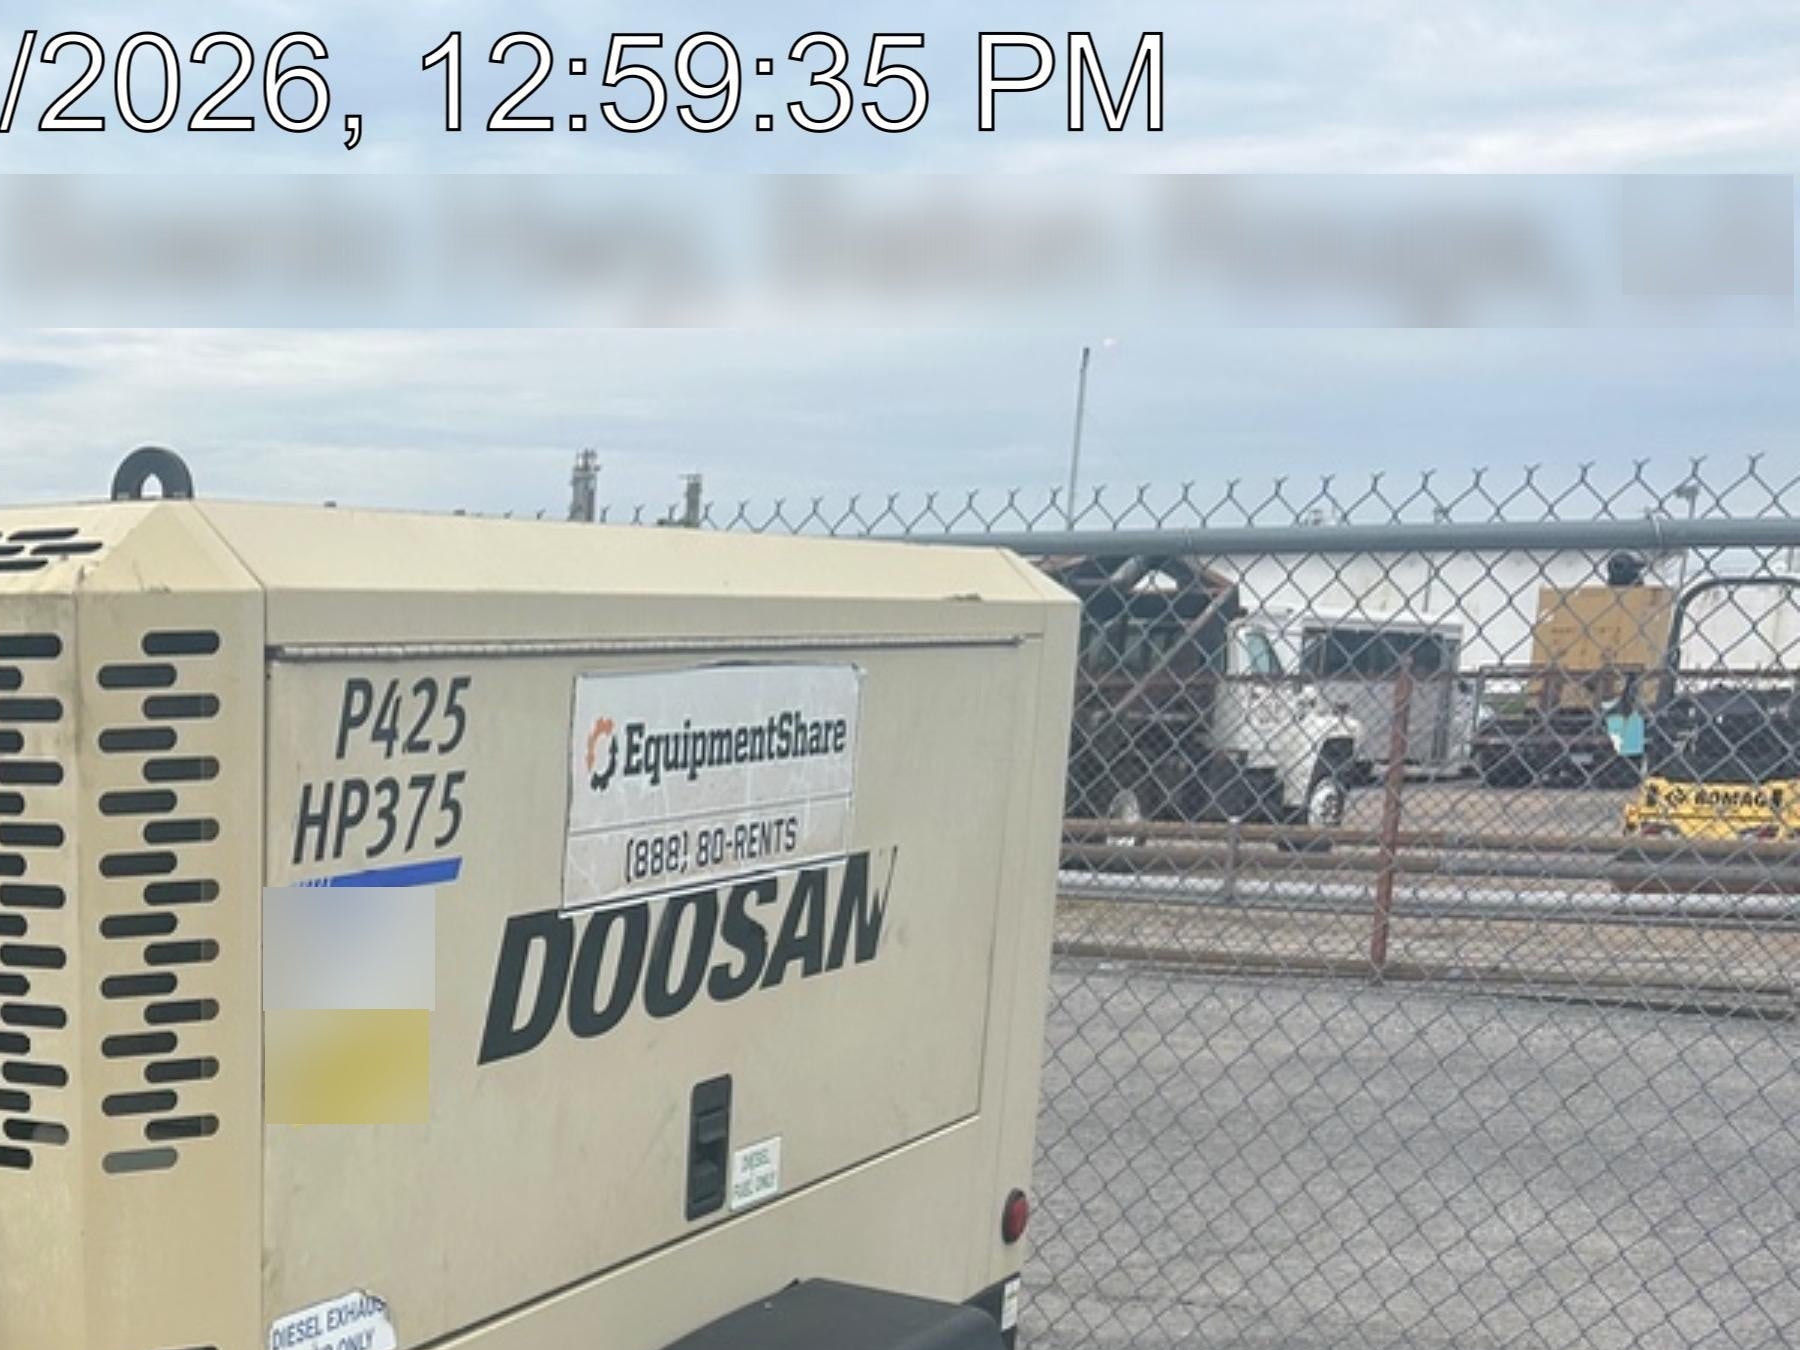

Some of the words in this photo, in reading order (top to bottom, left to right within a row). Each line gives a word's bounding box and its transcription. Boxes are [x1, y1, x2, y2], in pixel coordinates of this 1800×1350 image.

[336, 675, 471, 760] P425
[623, 711, 847, 786] EquipmentShare
[293, 770, 467, 865] HP375
[626, 831, 689, 883] (888)
[696, 816, 799, 868] 80-RENTS
[477, 846, 898, 1065] DOOSAN
[326, 1295, 388, 1333] EXHAUS
